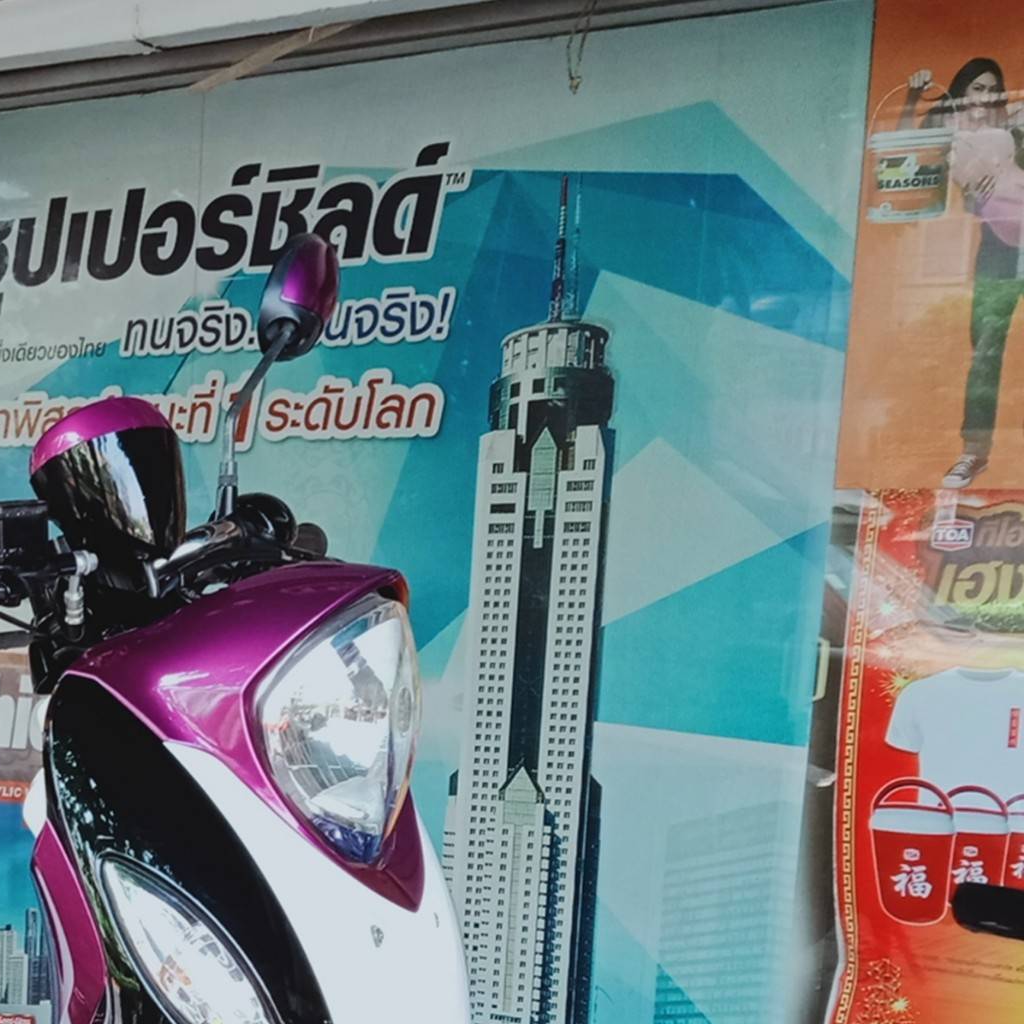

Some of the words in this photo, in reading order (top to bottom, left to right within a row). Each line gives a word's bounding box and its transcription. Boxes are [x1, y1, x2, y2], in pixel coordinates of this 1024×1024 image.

[265, 378, 437, 432] ระดับโลก
[936, 528, 969, 541] TOA
[889, 863, 933, 899] 福
